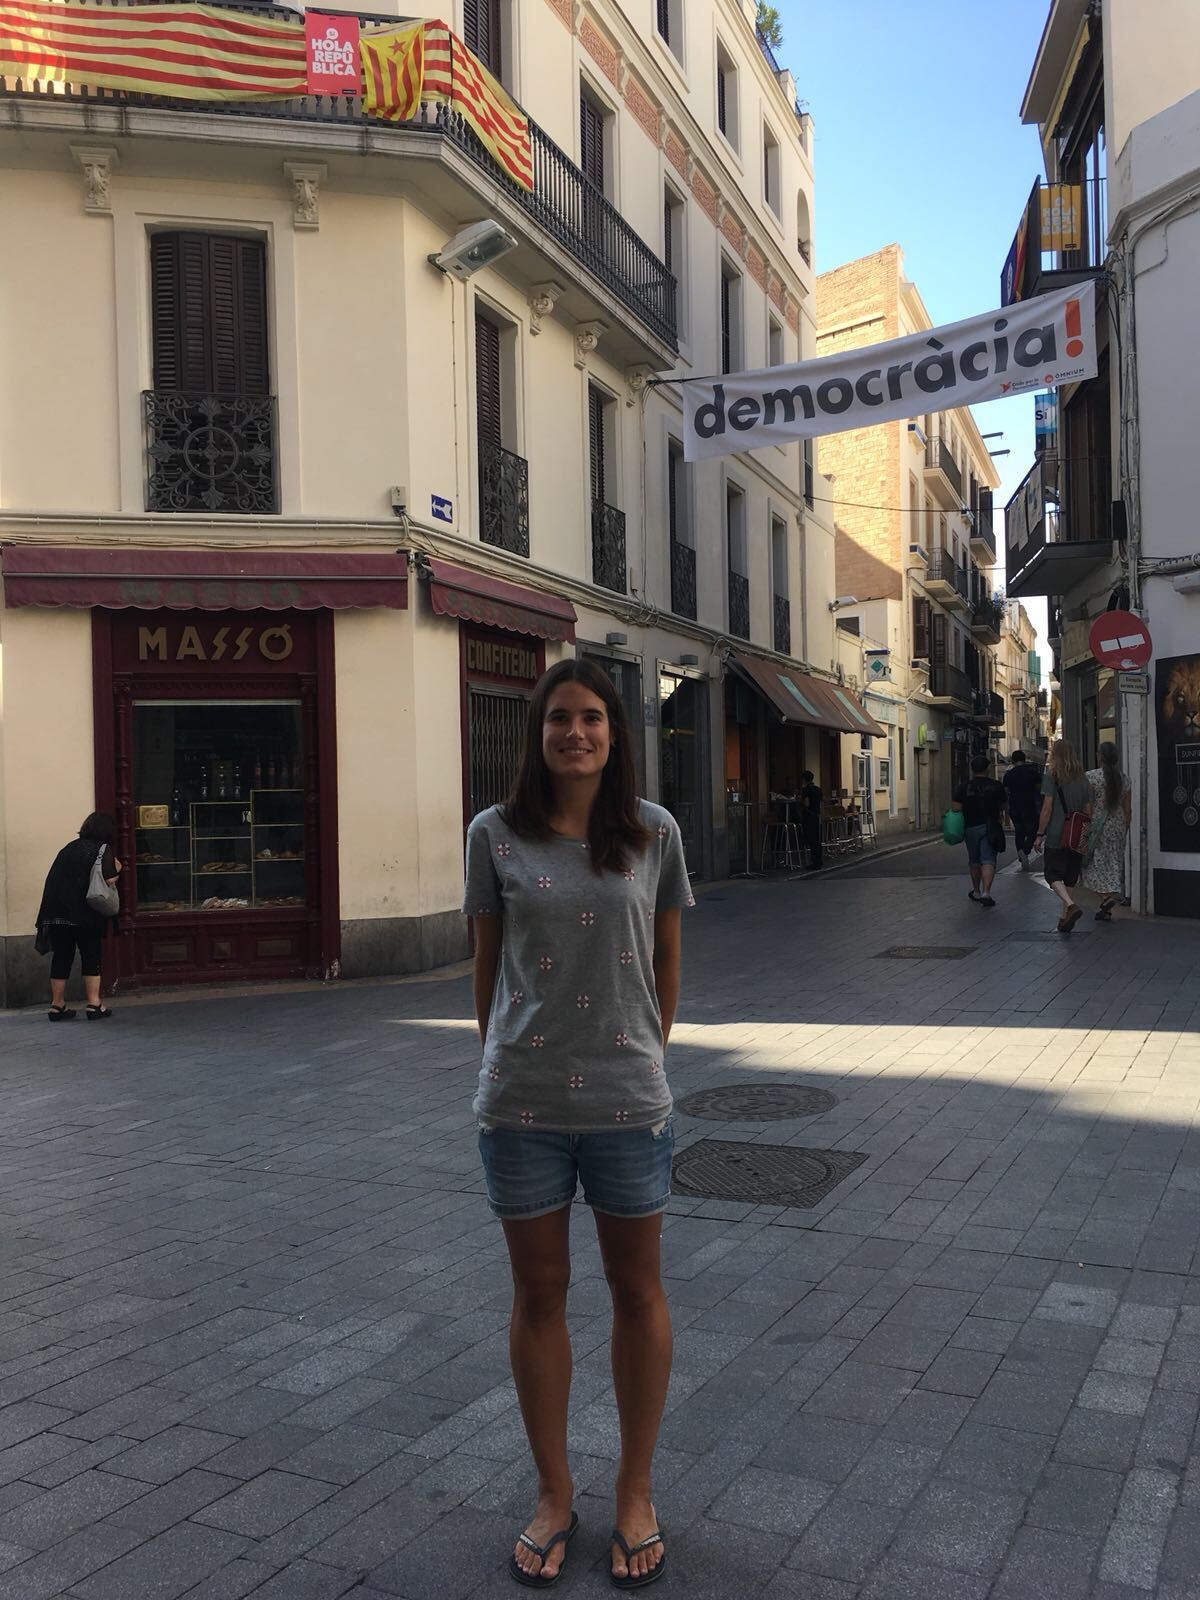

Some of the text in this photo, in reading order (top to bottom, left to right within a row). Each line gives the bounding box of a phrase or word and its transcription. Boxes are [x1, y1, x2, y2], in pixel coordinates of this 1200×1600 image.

[311, 38, 354, 53] HOLA
[312, 61, 356, 76] BLICA
[693, 299, 1082, 439] democràcia!
[467, 639, 538, 680] CONFITERIA
